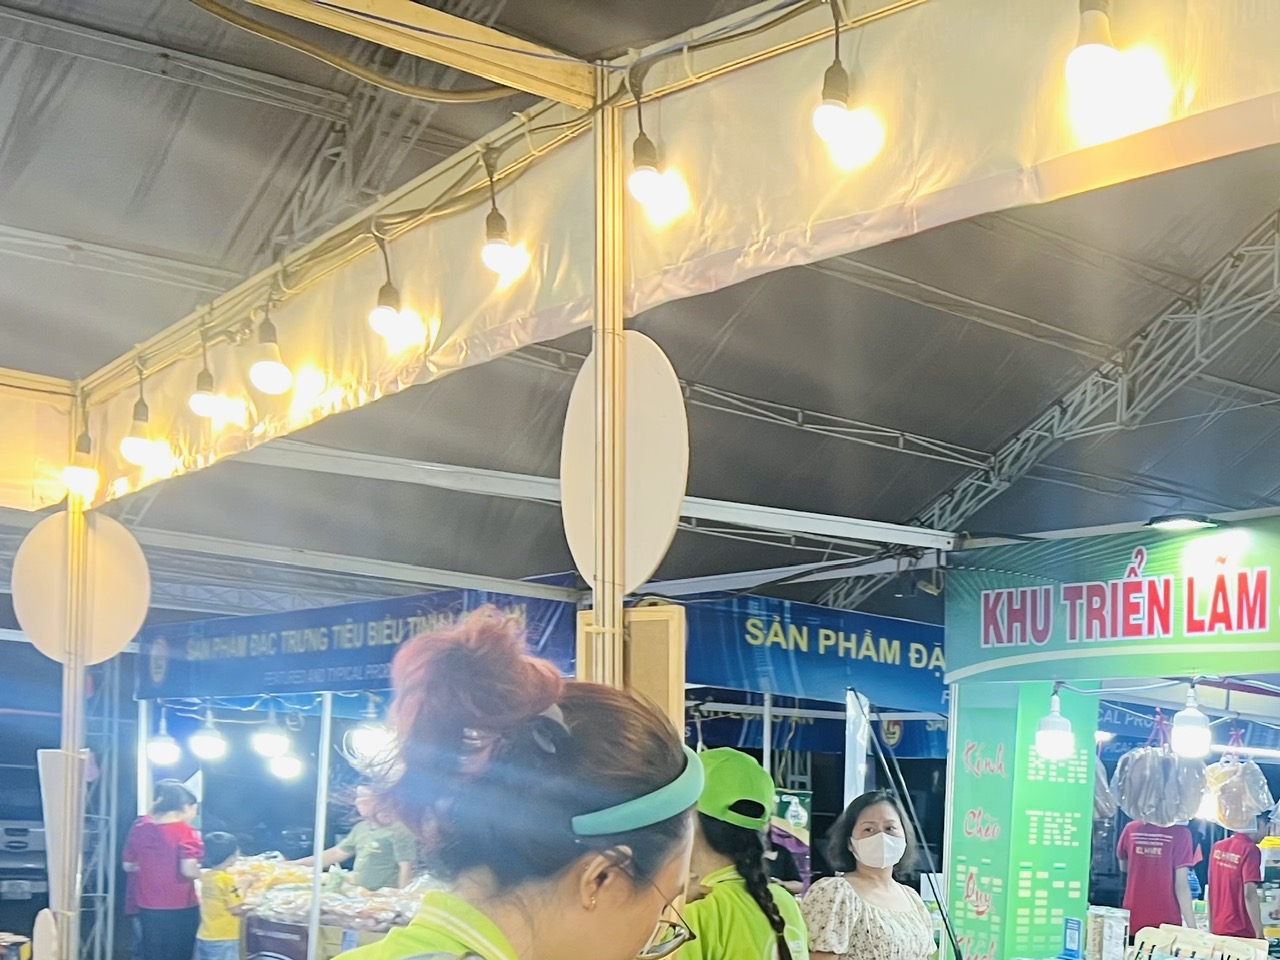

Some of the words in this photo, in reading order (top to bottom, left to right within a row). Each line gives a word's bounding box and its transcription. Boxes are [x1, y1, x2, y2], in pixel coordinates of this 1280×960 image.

[981, 585, 1052, 647] KHU
[1061, 546, 1173, 641] TRIỂN
[1184, 553, 1269, 637] LÃM
[280, 626, 329, 654] TRƯNG
[331, 617, 365, 650] TIÊU
[366, 612, 405, 647] BIỂU
[744, 615, 809, 653] SẢN
[818, 628, 901, 666] PHẨM
[908, 641, 946, 678] ĐẶ
[964, 741, 1007, 777] Kính
[964, 808, 1001, 841] Chào
[1025, 809, 1082, 847] TRE
